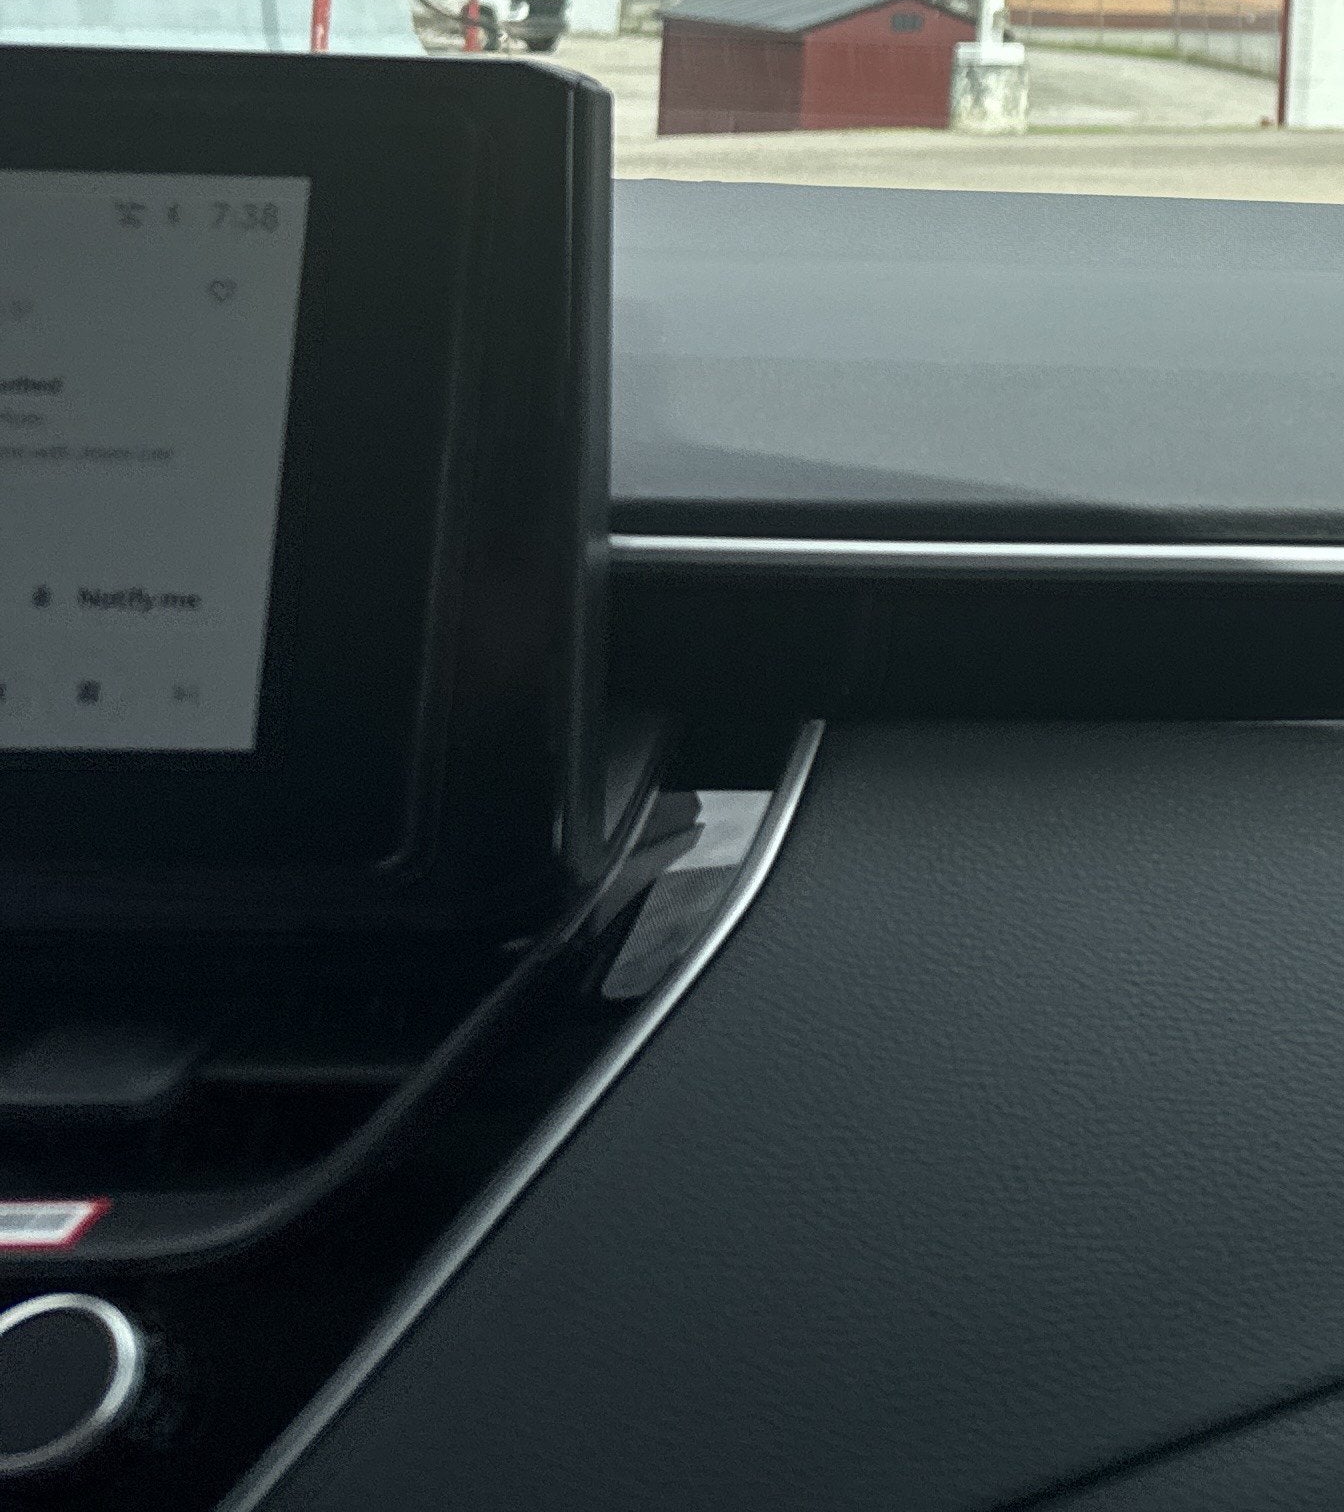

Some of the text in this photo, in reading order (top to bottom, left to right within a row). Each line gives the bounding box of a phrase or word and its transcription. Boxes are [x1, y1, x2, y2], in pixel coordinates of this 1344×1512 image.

[213, 202, 279, 230] 7:38
[79, 588, 201, 612] Notify me
